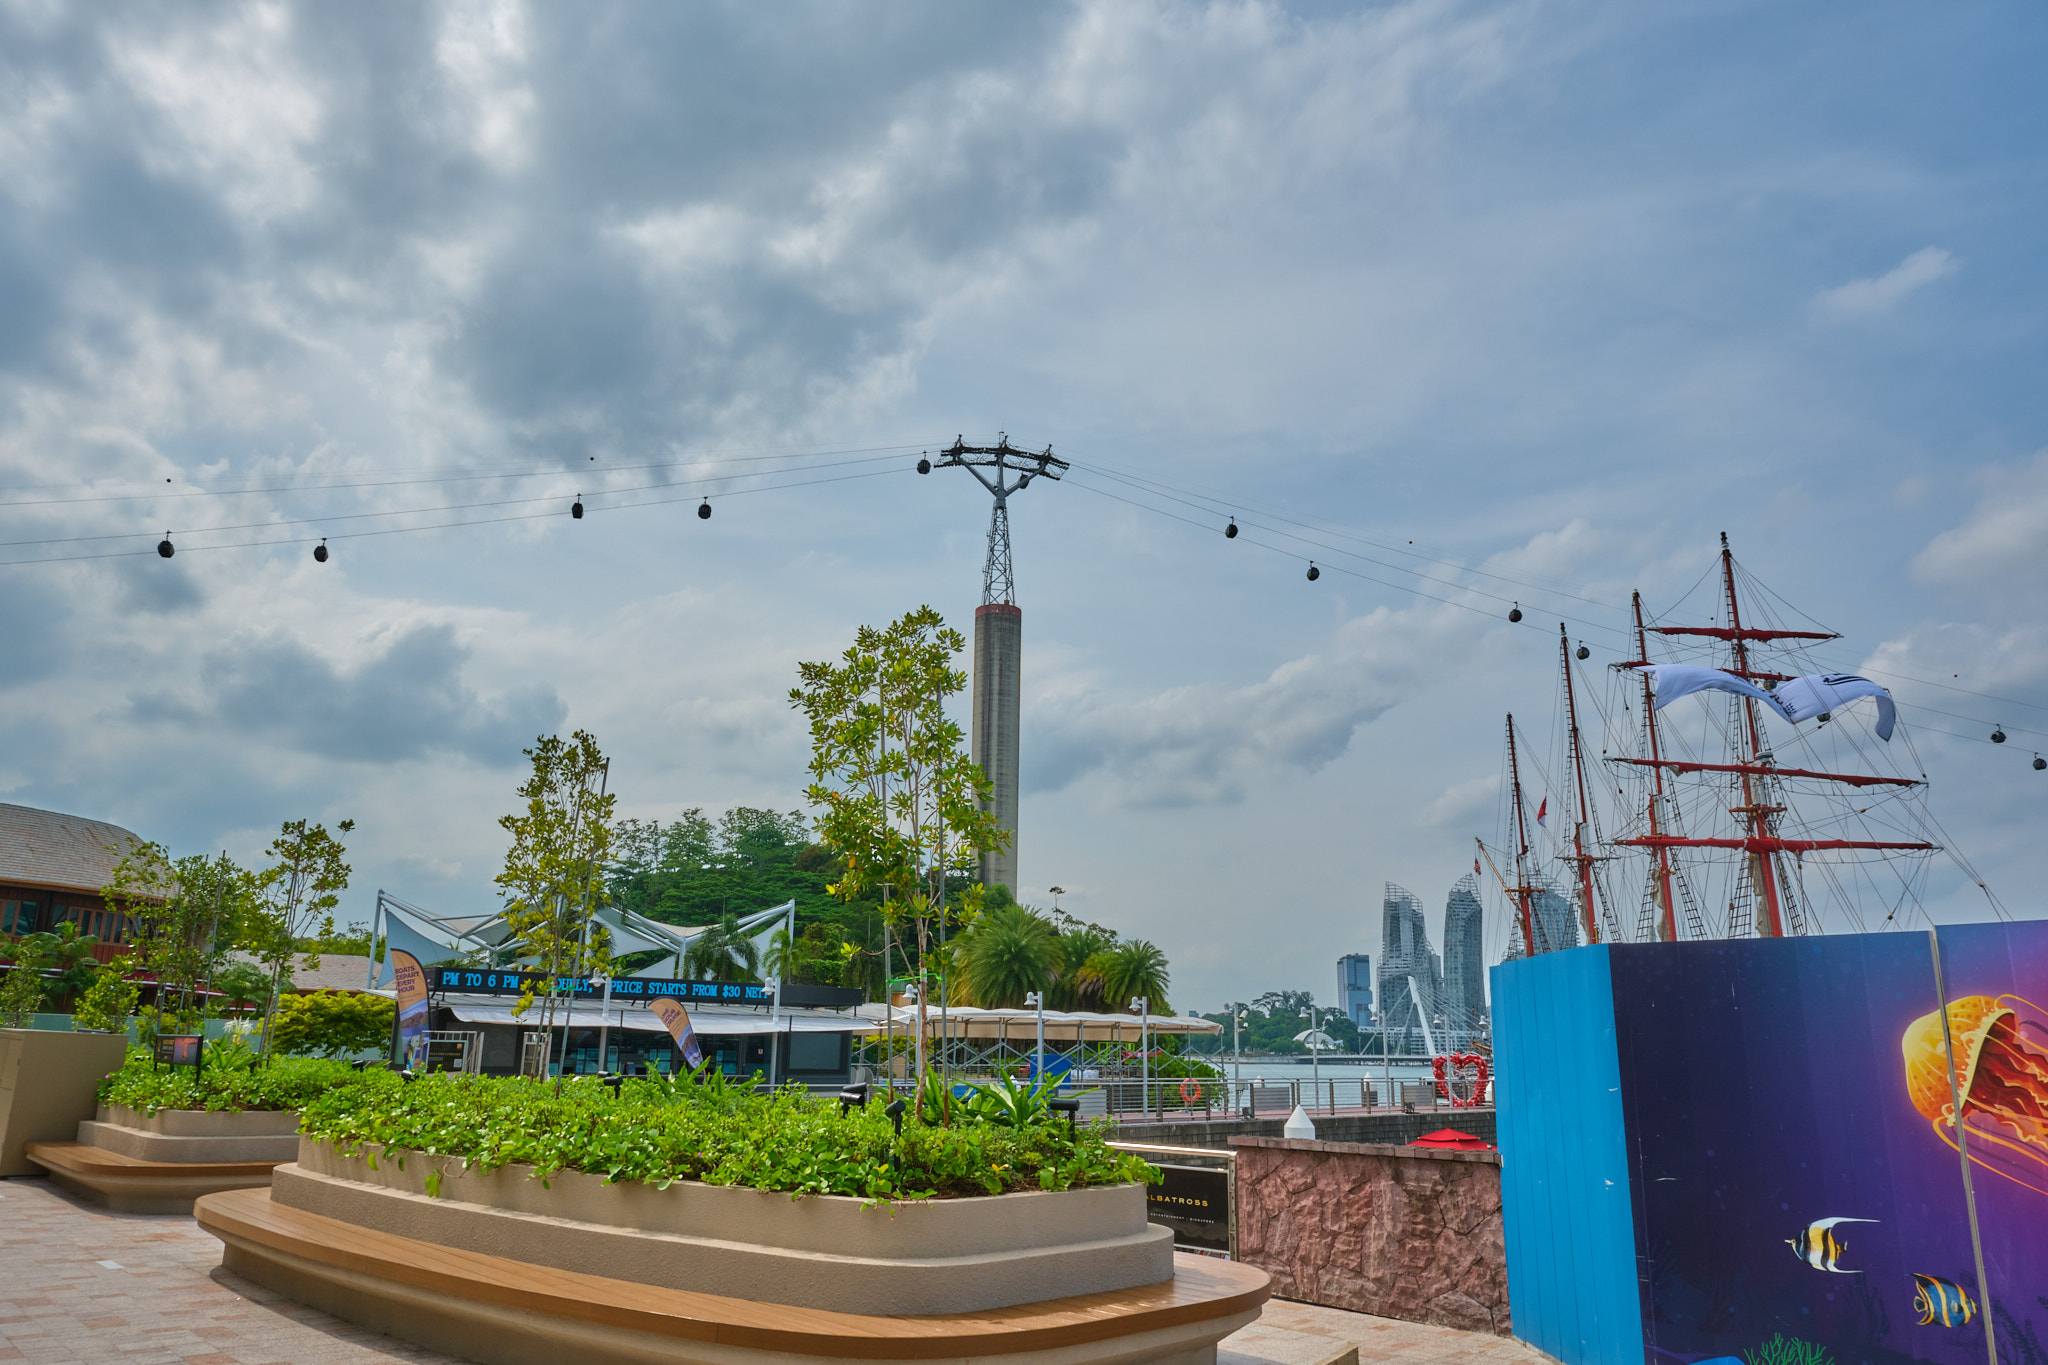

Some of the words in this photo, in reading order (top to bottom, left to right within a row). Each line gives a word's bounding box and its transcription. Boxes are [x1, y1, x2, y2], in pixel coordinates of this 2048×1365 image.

[395, 966, 415, 974] BOATS
[396, 971, 419, 981] DEPART
[397, 979, 415, 988] EVERY
[442, 971, 461, 986] PM
[465, 972, 482, 987] TO
[487, 974, 497, 988] 6
[502, 975, 520, 989] PM
[550, 977, 593, 994] OURLY,
[610, 980, 643, 994] PRICE
[648, 982, 687, 996] STARTS
[692, 984, 718, 997] FROM
[722, 984, 741, 999] $30
[398, 985, 415, 993] HOUR
